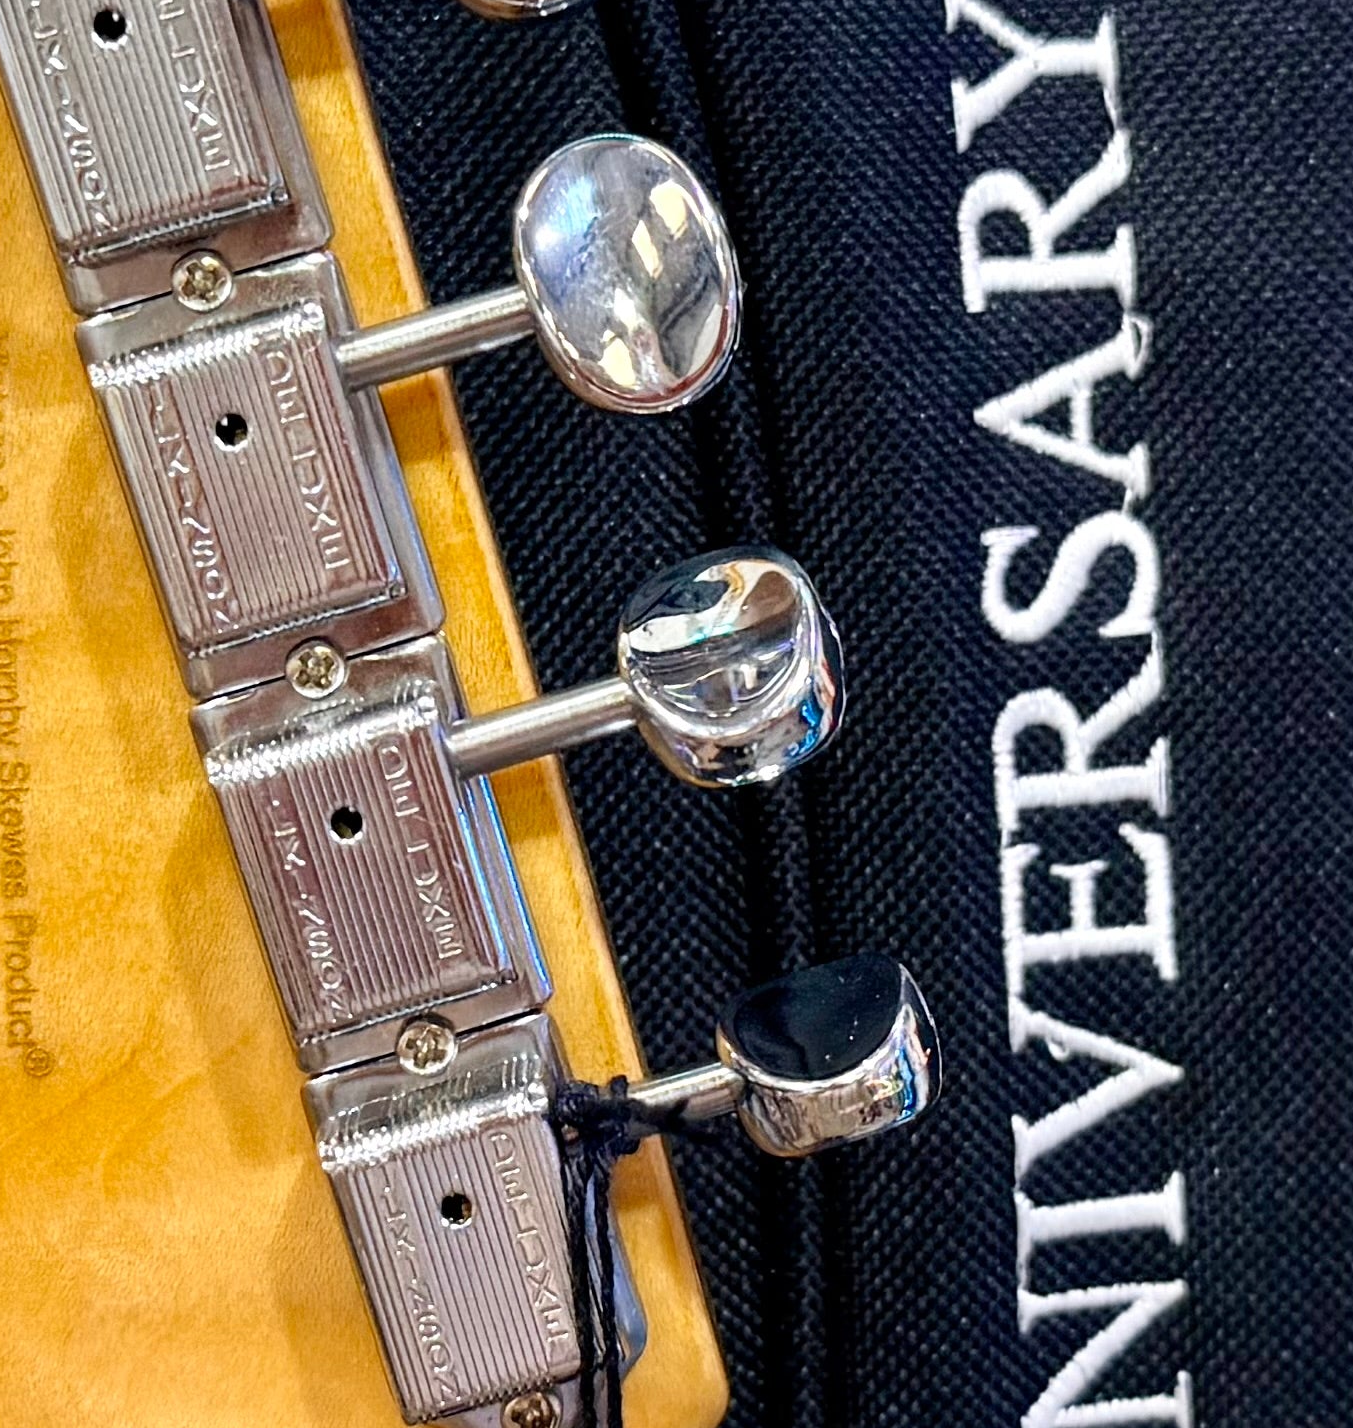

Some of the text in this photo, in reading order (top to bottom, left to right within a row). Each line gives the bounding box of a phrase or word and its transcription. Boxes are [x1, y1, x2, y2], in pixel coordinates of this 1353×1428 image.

[264, 349, 350, 570] DELUXE
[378, 745, 463, 960] DELUXE
[489, 1131, 570, 1345] DELUXE
